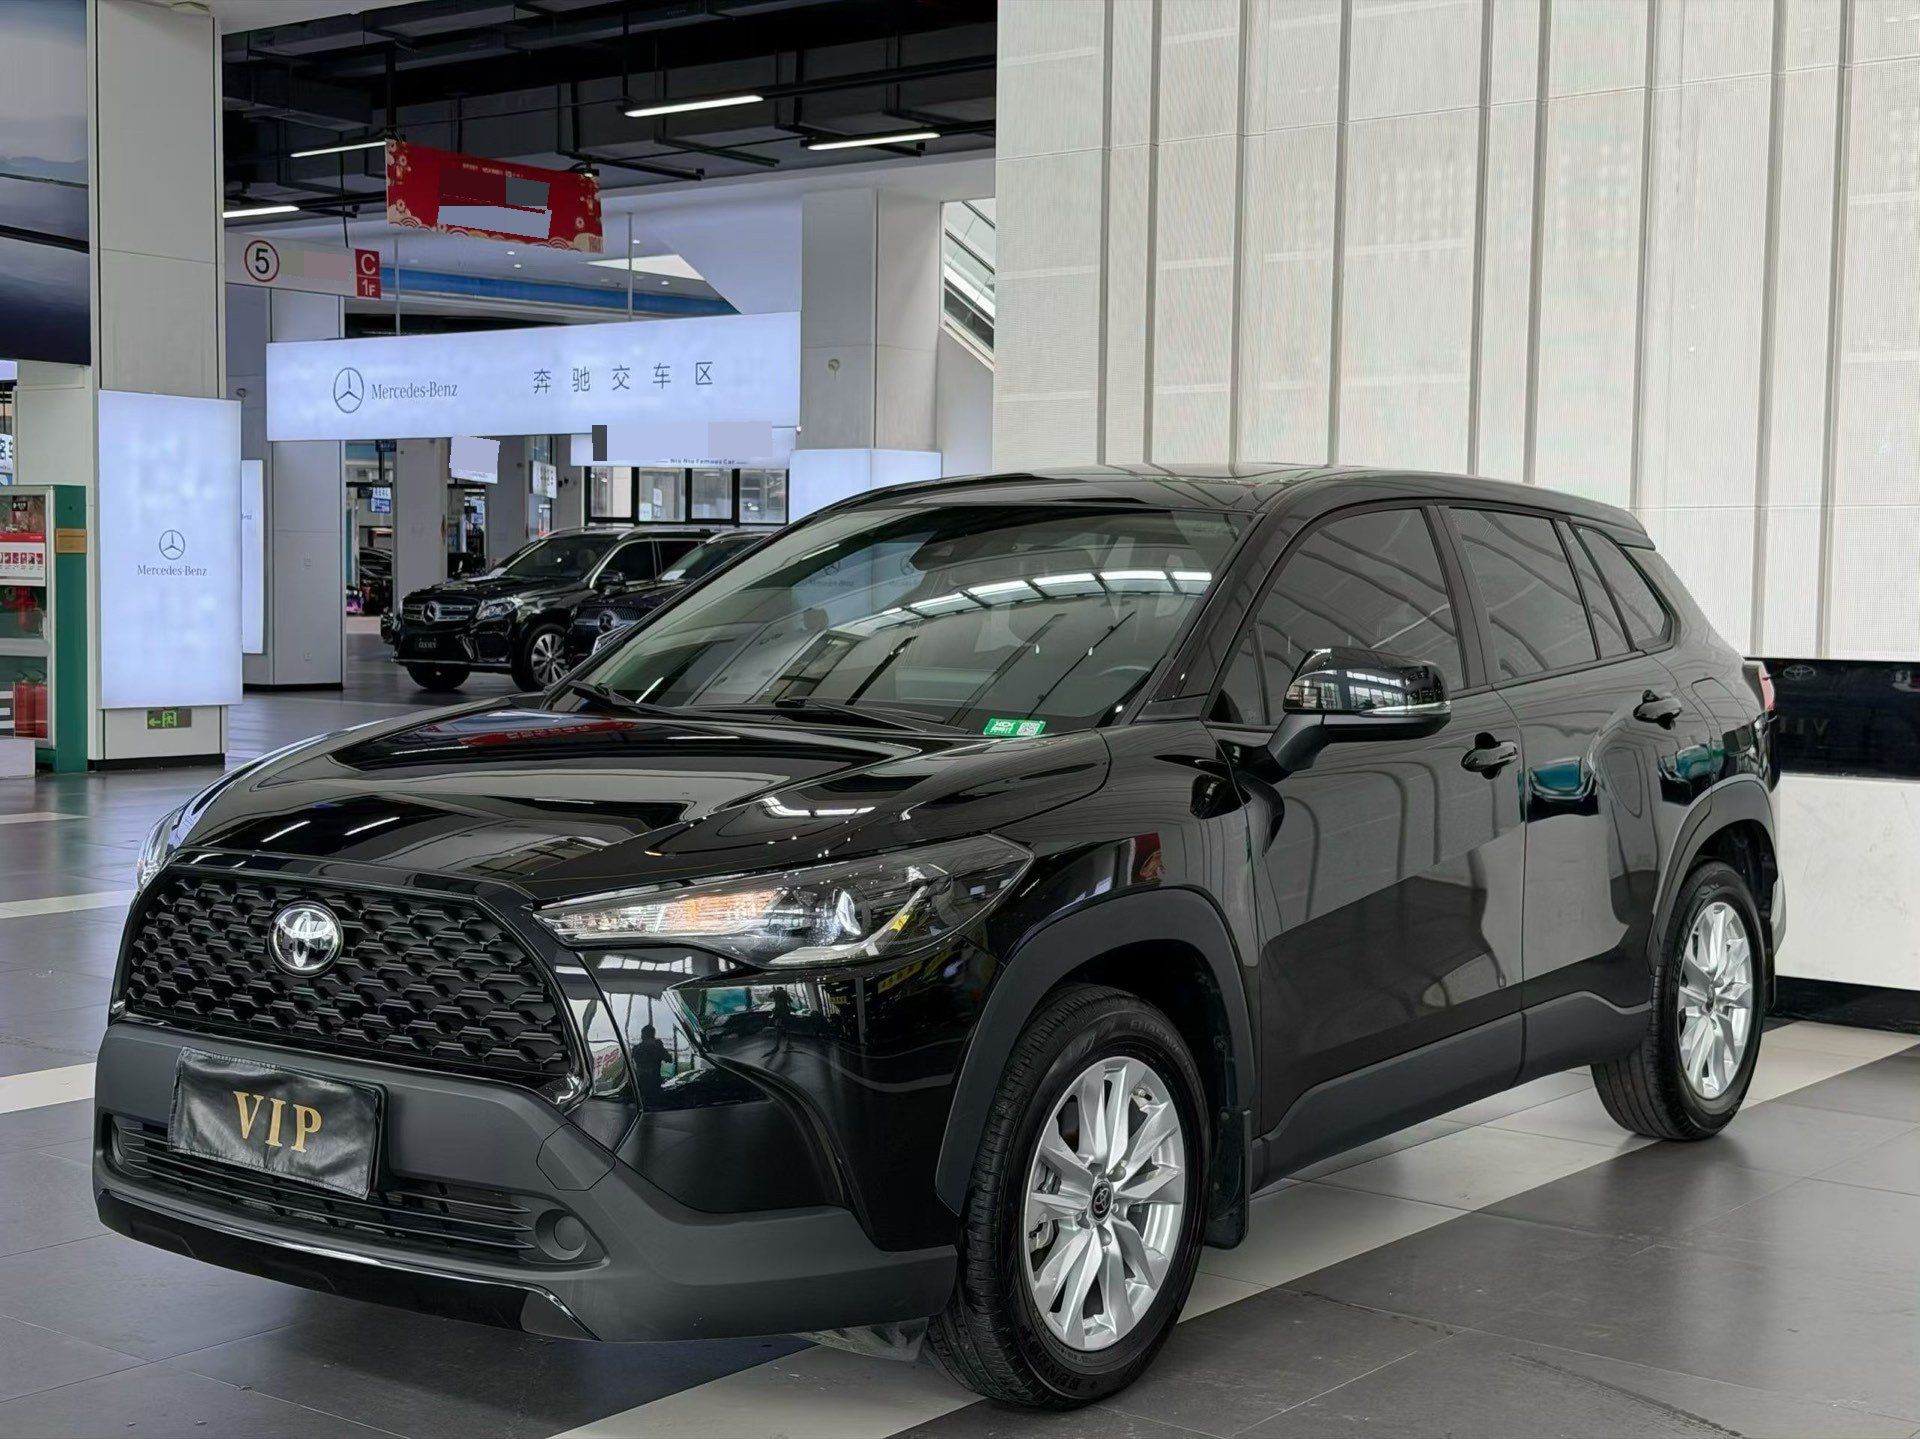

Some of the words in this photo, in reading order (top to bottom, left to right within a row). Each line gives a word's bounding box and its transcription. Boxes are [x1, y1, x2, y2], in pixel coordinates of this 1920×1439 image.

[255, 248, 270, 274] 5
[360, 253, 376, 275] C
[361, 279, 376, 297] 1F
[533, 361, 714, 395] 奔驰交车区
[371, 381, 458, 400] Mercedes-Benz
[137, 564, 208, 577] Mercedes-Benz
[232, 1089, 323, 1154] VIP
